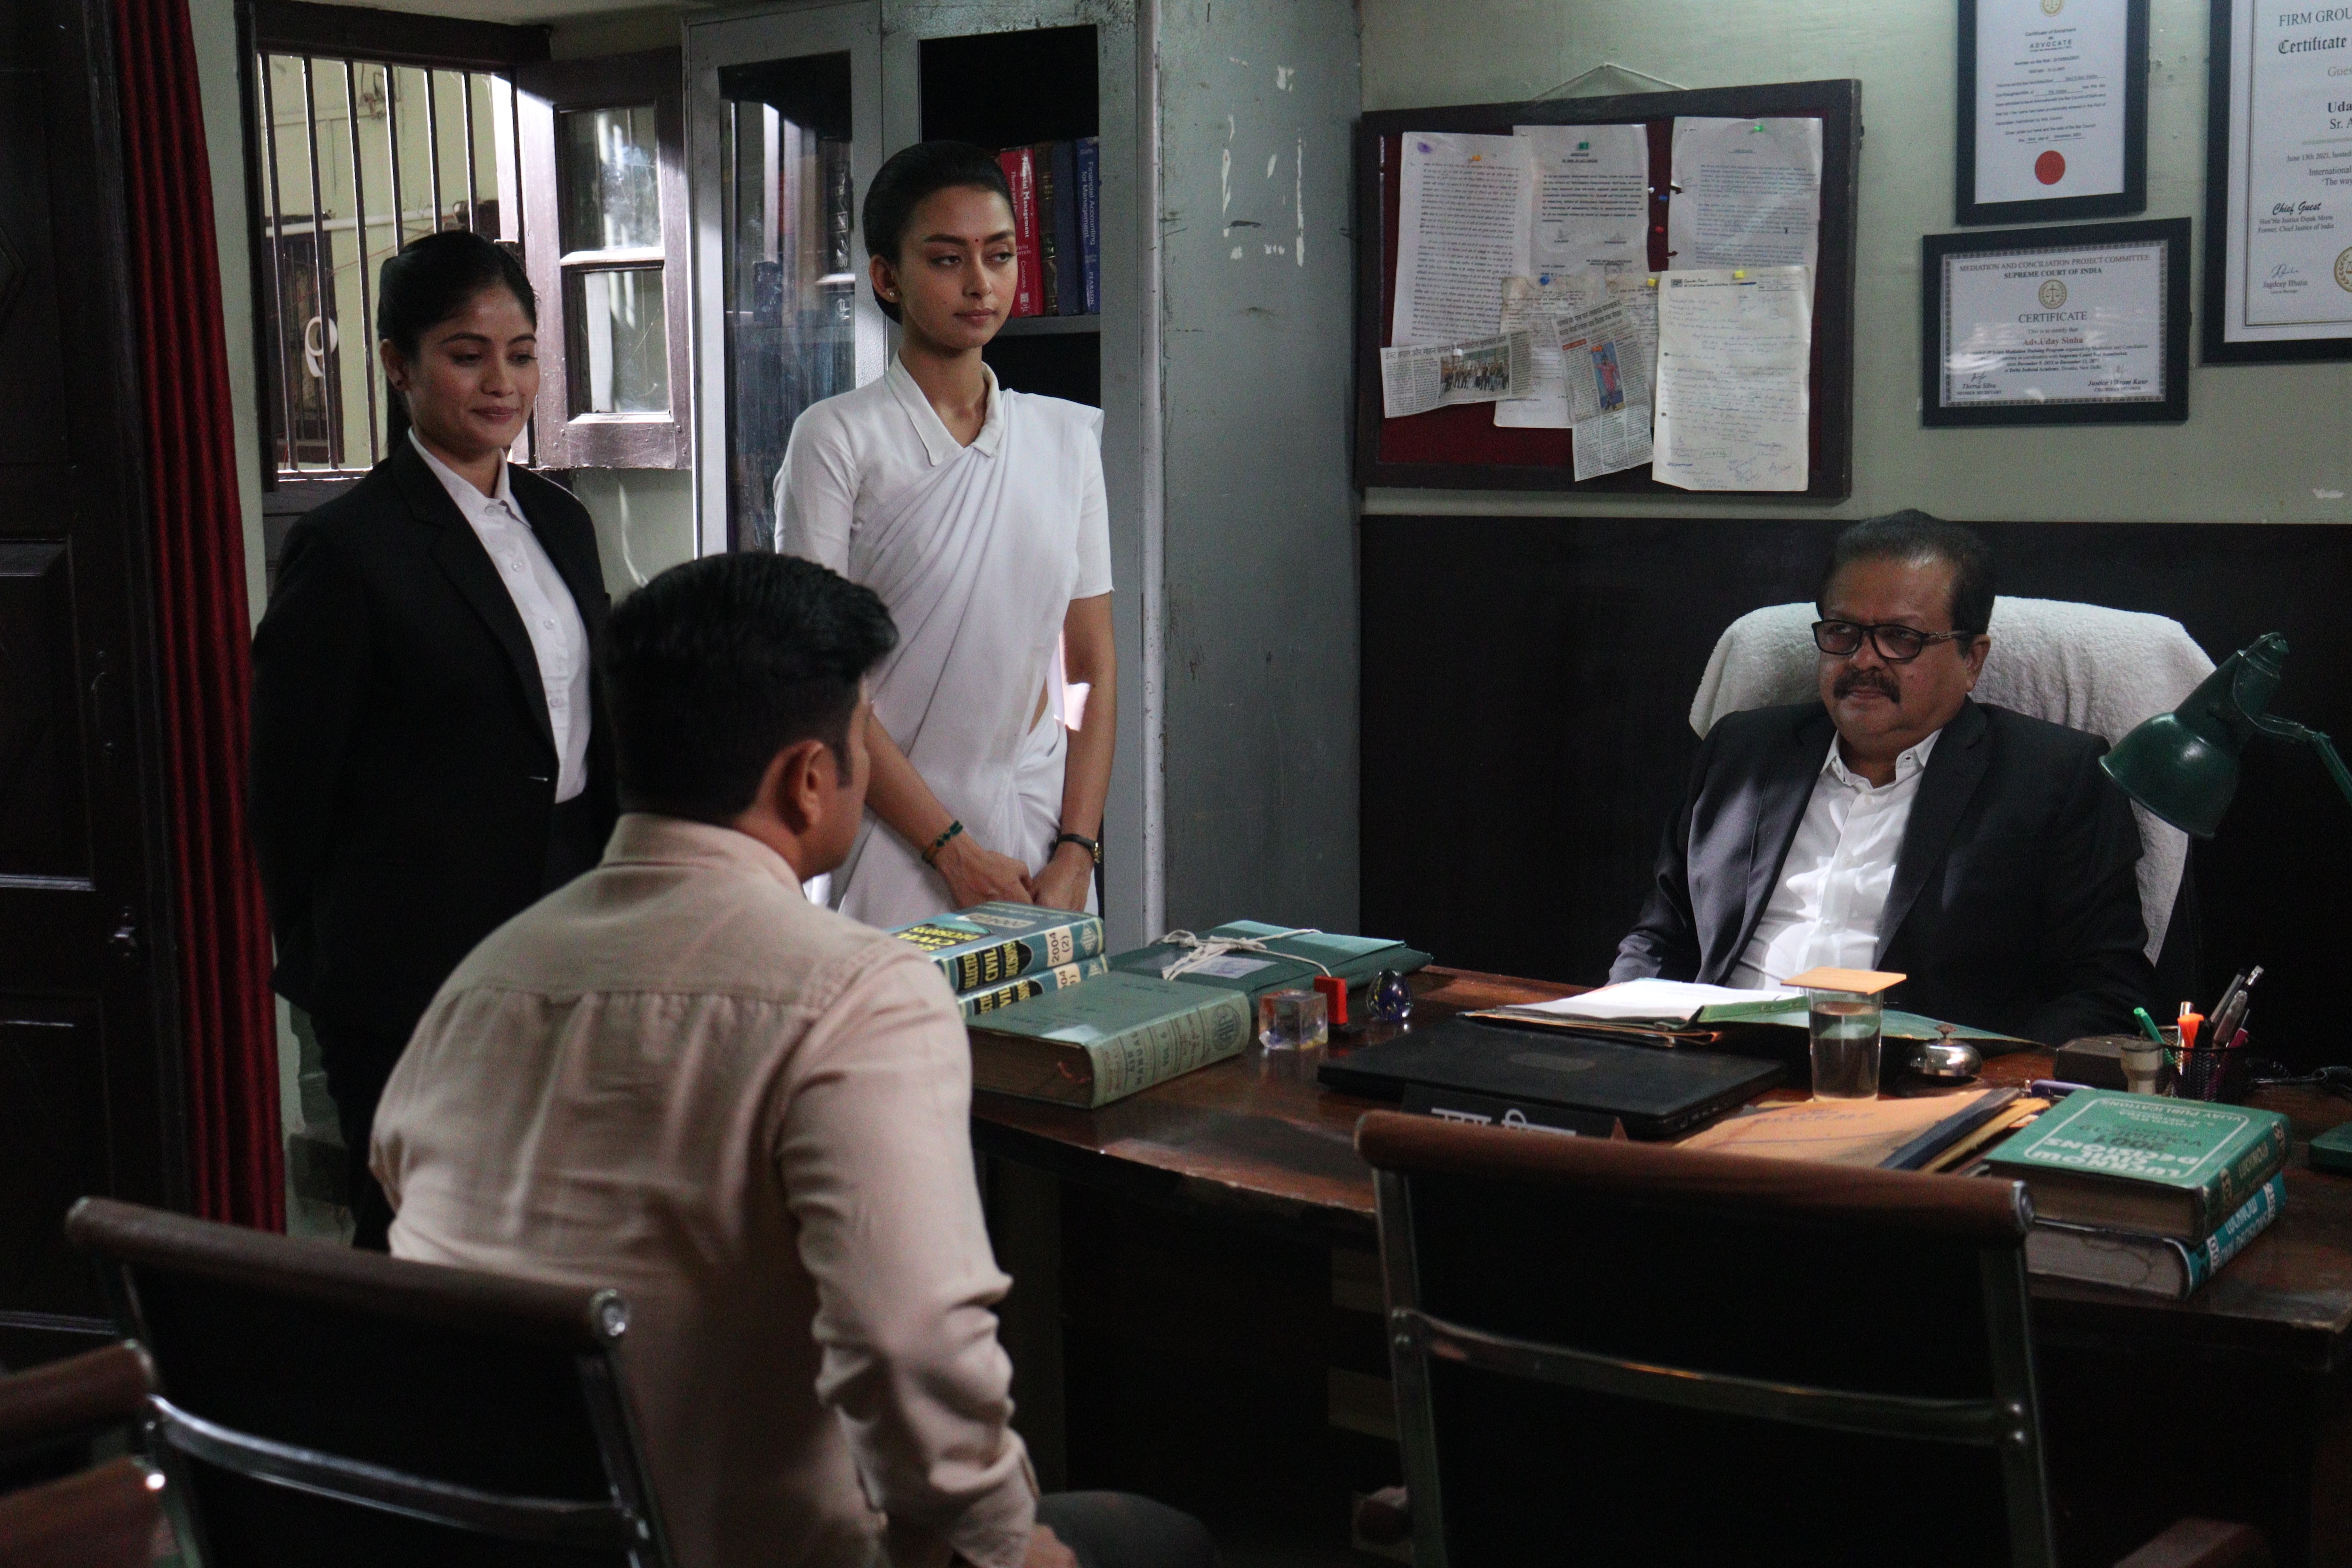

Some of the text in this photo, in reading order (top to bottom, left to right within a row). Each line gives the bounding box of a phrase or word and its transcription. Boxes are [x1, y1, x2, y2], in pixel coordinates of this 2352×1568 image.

[2280, 12, 2312, 26] FIRM
[2030, 39, 2072, 48] ADVOCATE
[2278, 37, 2347, 54] Certificate
[2330, 118, 2343, 129] Sr.
[2309, 166, 2352, 176] International
[1021, 156, 1031, 238] Financial Management
[2273, 201, 2321, 215] Chief Guest
[1960, 263, 1999, 271] MEDIATION
[2018, 259, 2069, 269] CONCILIATION
[2018, 311, 2087, 323] CERTIFICATE
[1061, 935, 1070, 953] (2)
[964, 952, 978, 988] SELECTED
[985, 948, 998, 982] CIVIL
[1059, 970, 1068, 985] 04
[1131, 1032, 1144, 1085] MANUAL
[2101, 1100, 2199, 1117] PUBLICATIONS
[2203, 1113, 2241, 1122] VIJAY
[2043, 1138, 2200, 1165] DECISIONS
[2033, 1151, 2181, 1177] LUCKNOW
